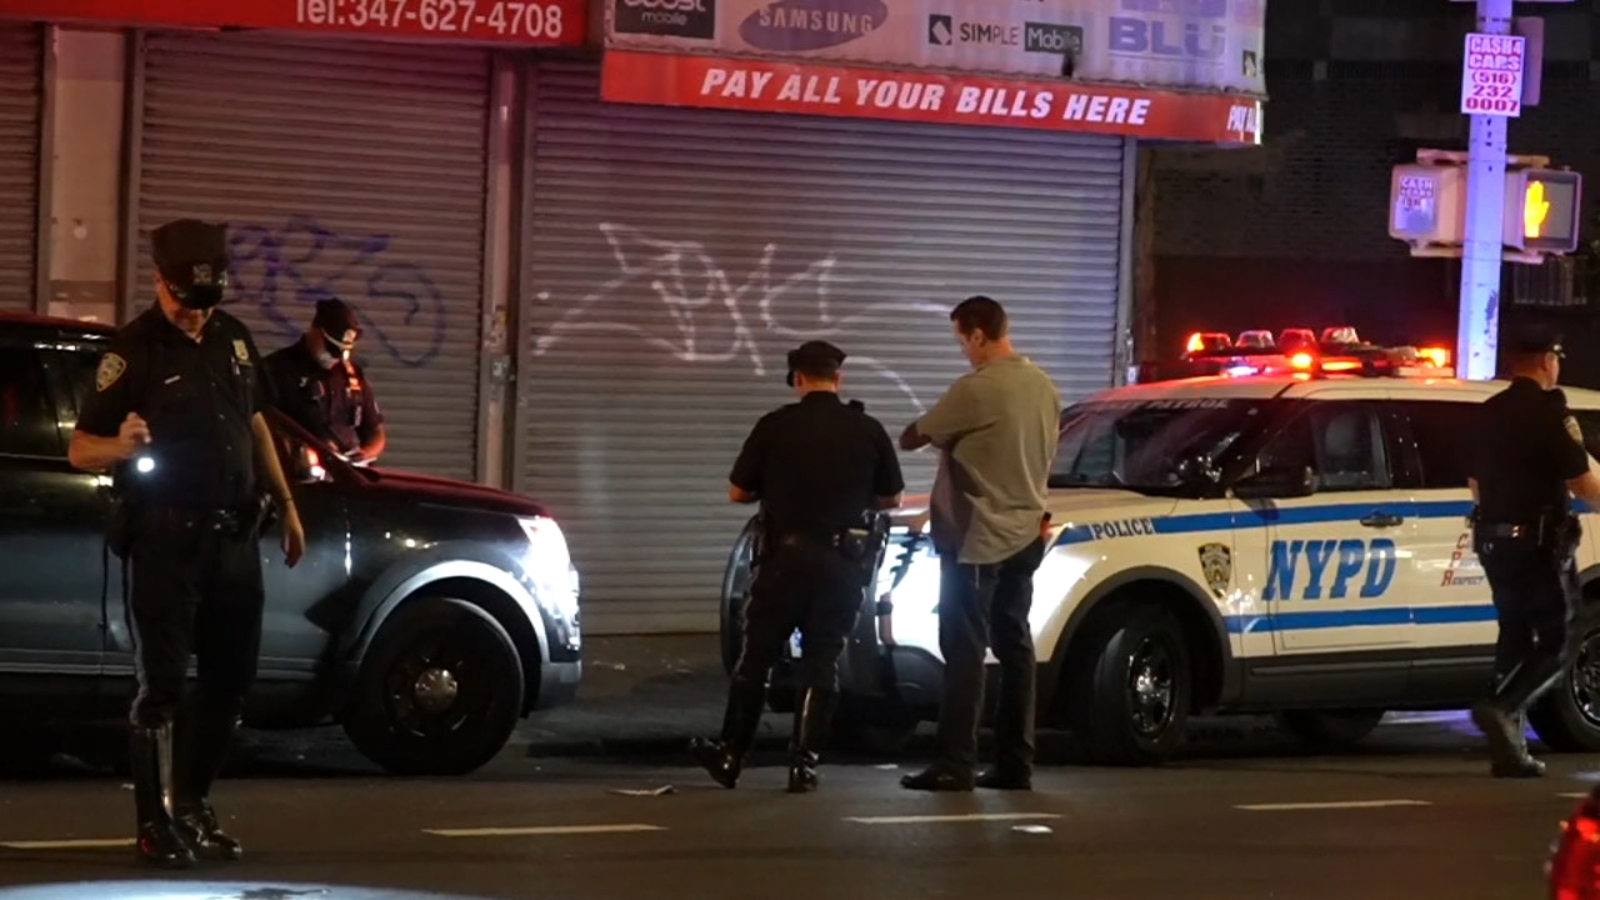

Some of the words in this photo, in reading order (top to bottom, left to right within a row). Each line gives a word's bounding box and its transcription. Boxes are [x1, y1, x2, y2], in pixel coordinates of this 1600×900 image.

[625, 0, 706, 12] ost
[641, 11, 687, 26] mobile
[759, 9, 873, 33] SAMSUNG
[960, 22, 1020, 46] SIMPLE
[1027, 28, 1080, 51] Mobile
[1469, 53, 1521, 71] CARS
[1471, 71, 1517, 85] (516)
[701, 68, 773, 99] PAY
[777, 74, 842, 104] ALL
[856, 79, 945, 111] YOUR
[956, 86, 1054, 119] BILLS
[1063, 93, 1151, 125] HERE
[1473, 84, 1513, 98] 232
[1466, 97, 1518, 112] 0007
[1093, 519, 1152, 540] POLICE
[1262, 538, 1396, 600] NYPD
